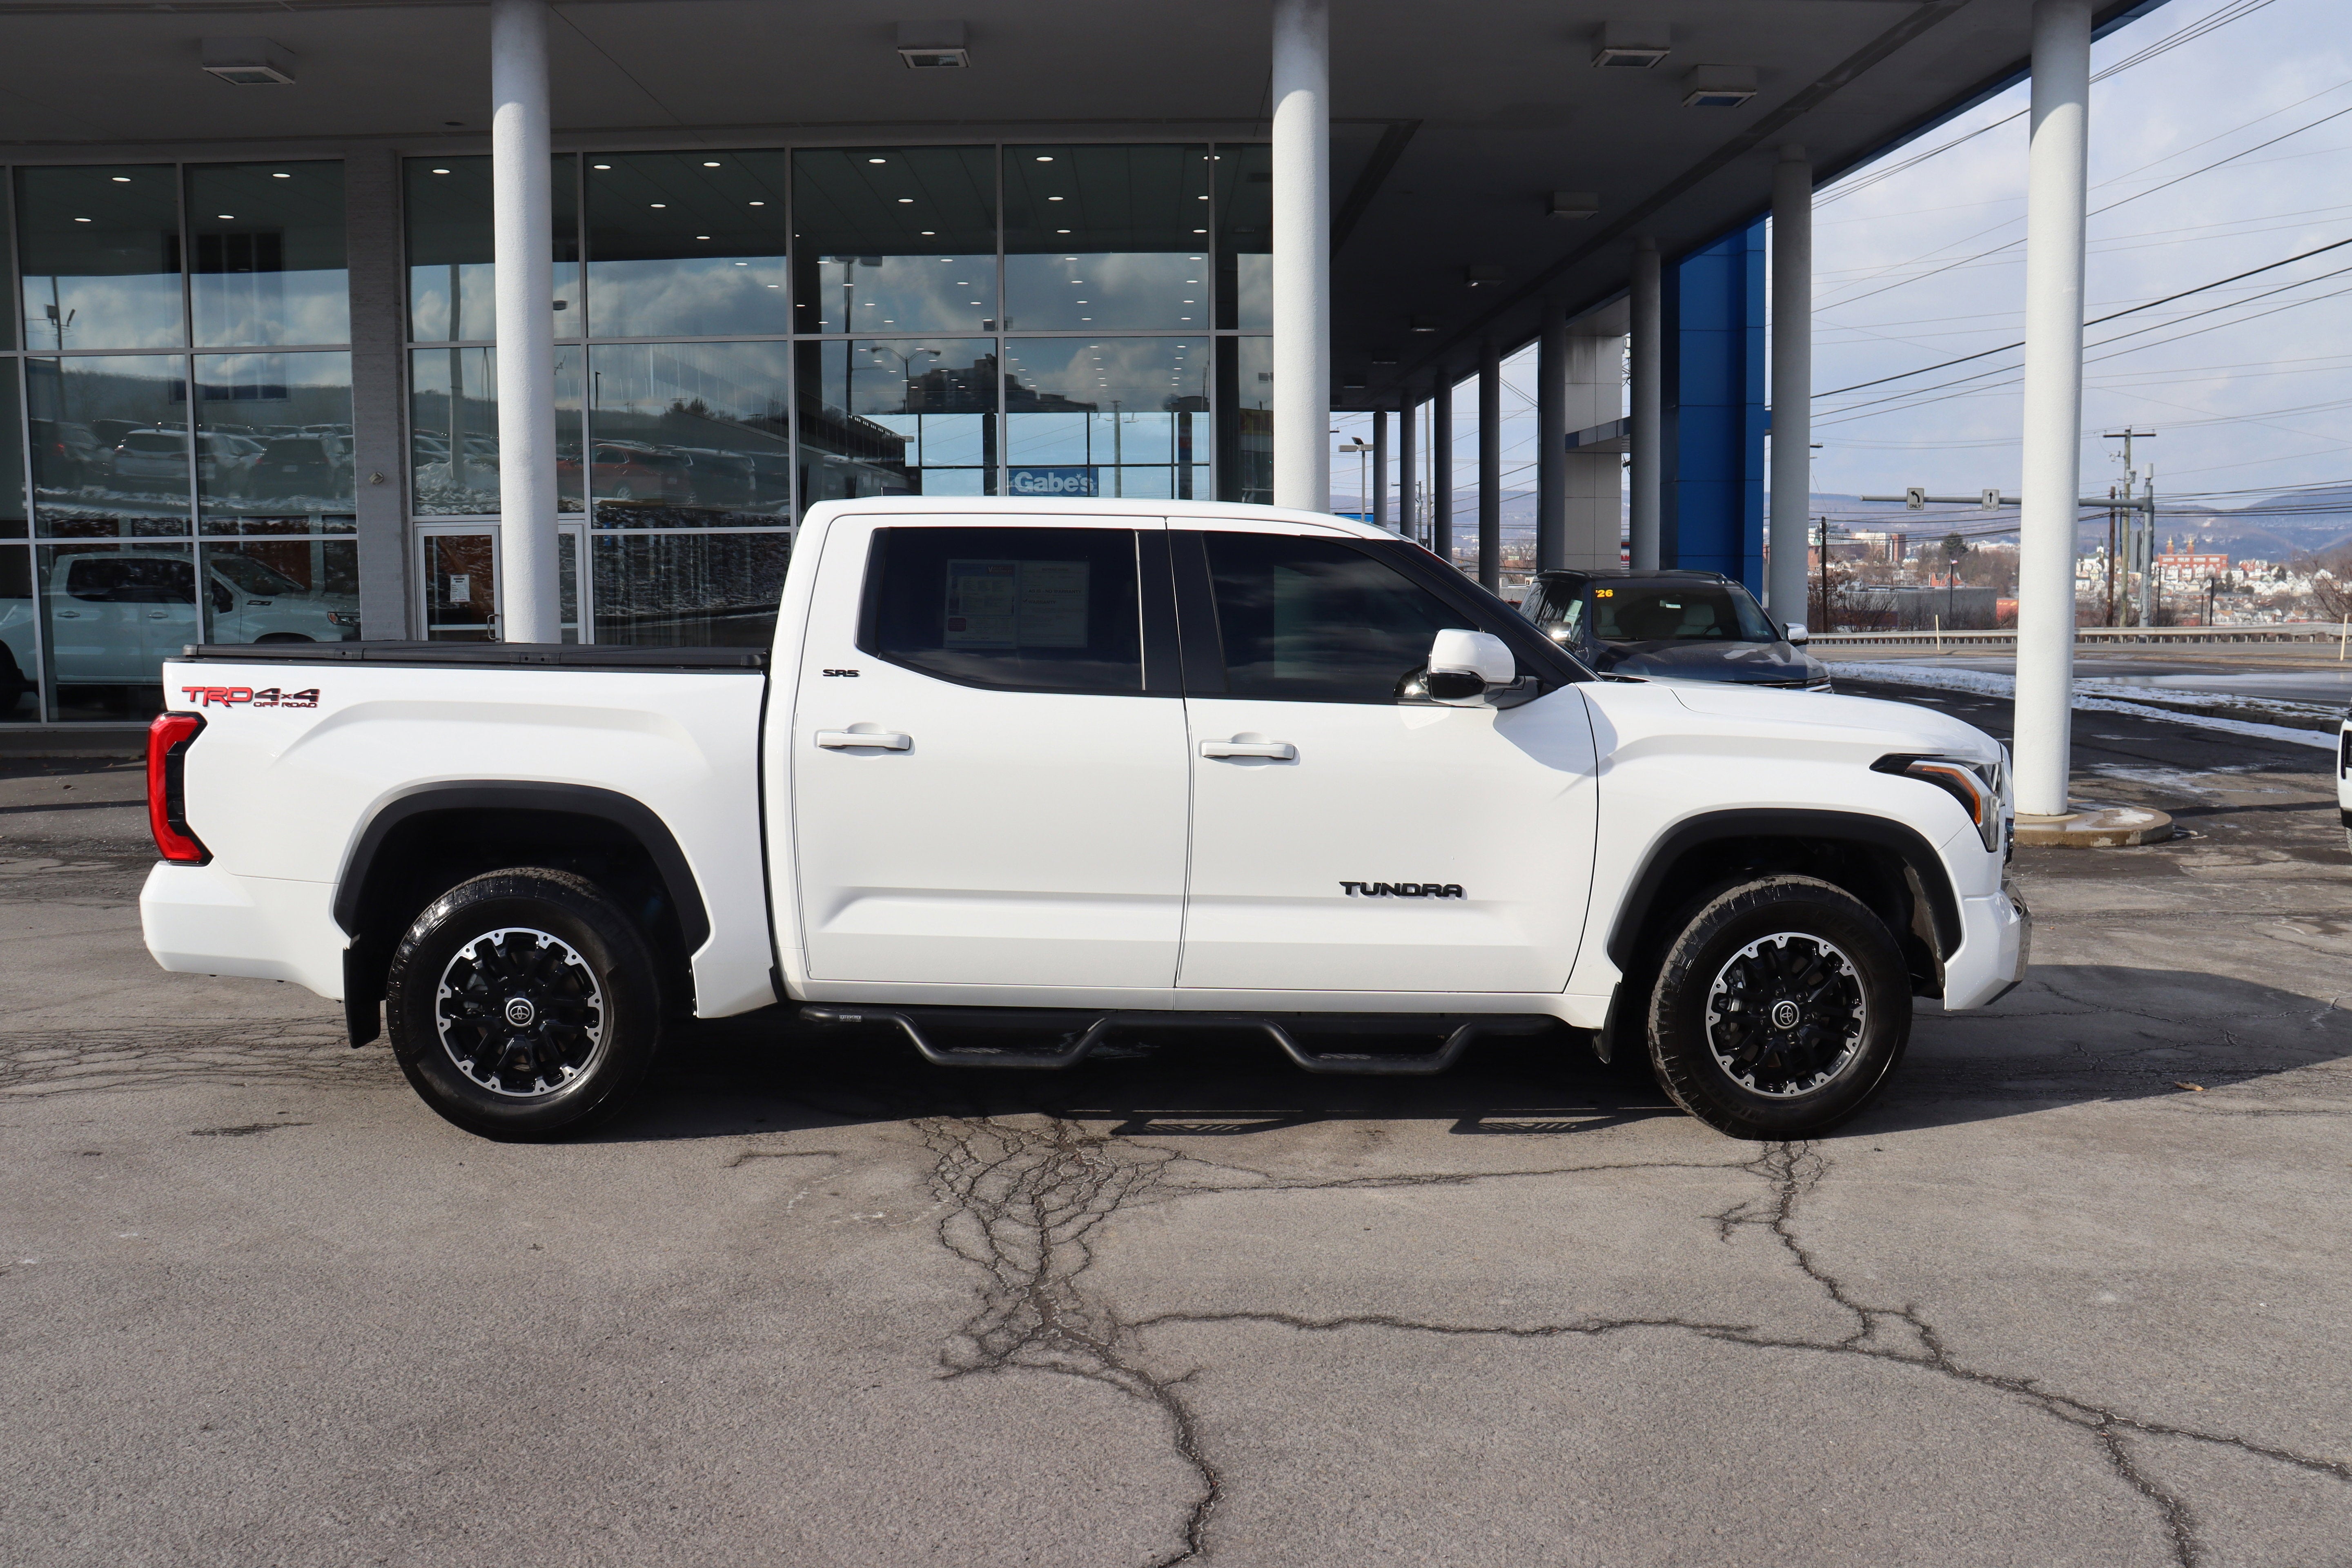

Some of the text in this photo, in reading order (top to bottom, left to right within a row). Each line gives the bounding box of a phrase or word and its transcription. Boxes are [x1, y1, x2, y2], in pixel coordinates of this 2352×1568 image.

[1595, 589, 1613, 598] '26
[182, 686, 253, 708] TRD
[1339, 881, 1462, 897] TUNDRA
